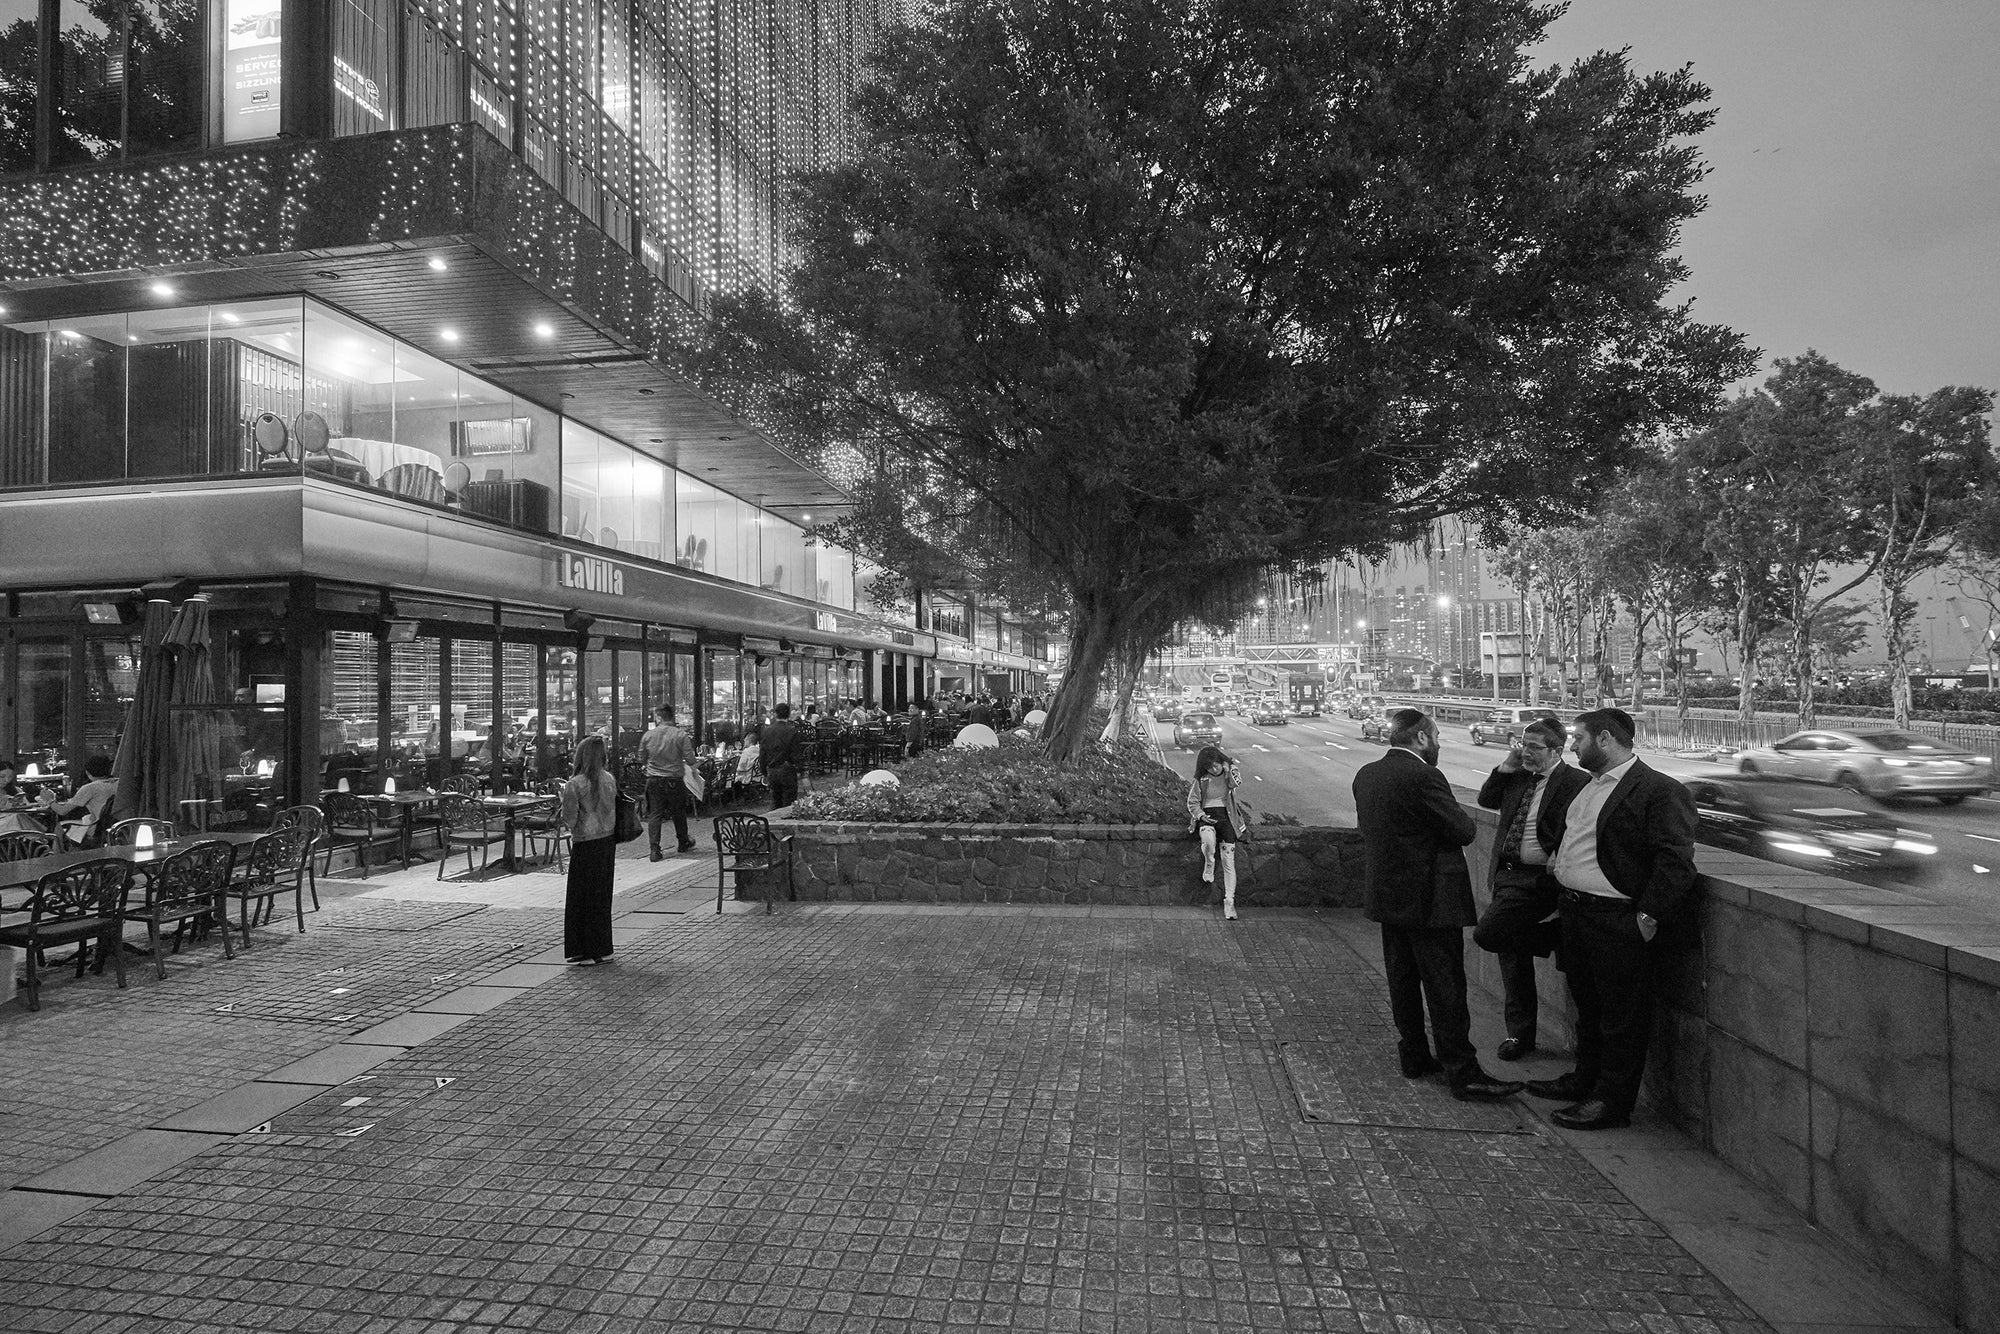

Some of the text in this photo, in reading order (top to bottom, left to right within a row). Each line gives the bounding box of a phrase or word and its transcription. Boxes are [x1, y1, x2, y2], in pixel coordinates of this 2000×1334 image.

[333, 55, 365, 86] UTH'S
[470, 87, 507, 129] UTH'S
[524, 135, 544, 161] RIS
